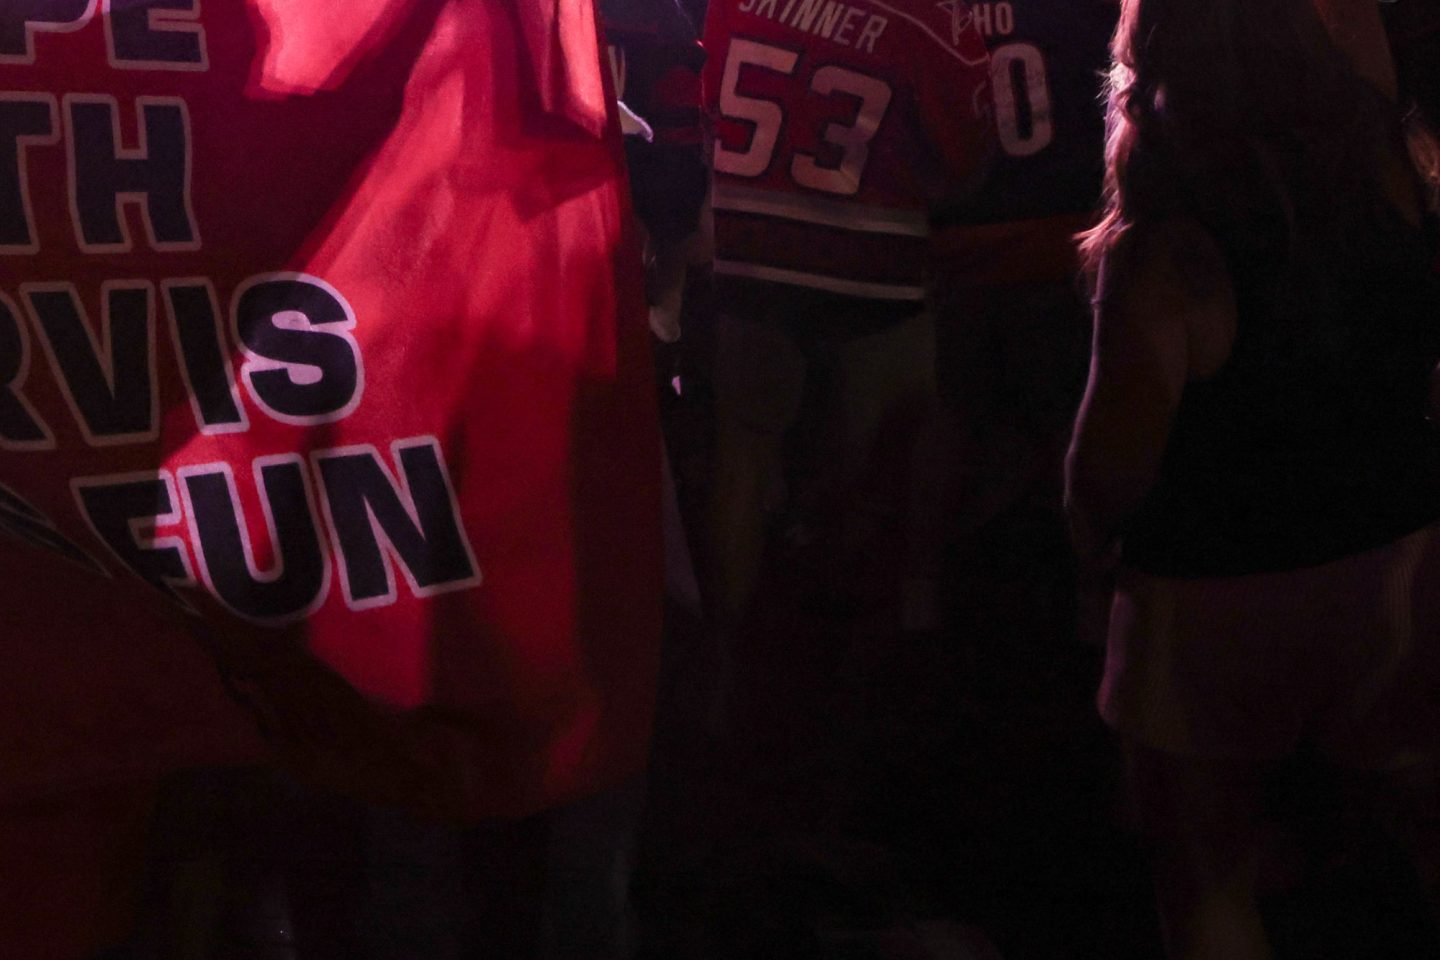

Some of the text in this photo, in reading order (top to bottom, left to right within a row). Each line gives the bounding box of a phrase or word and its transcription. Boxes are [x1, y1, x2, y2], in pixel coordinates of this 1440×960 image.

[971, 2, 1015, 37] HO
[713, 38, 893, 196] 53
[990, 42, 1053, 158] 0
[68, 434, 483, 628] FUN
